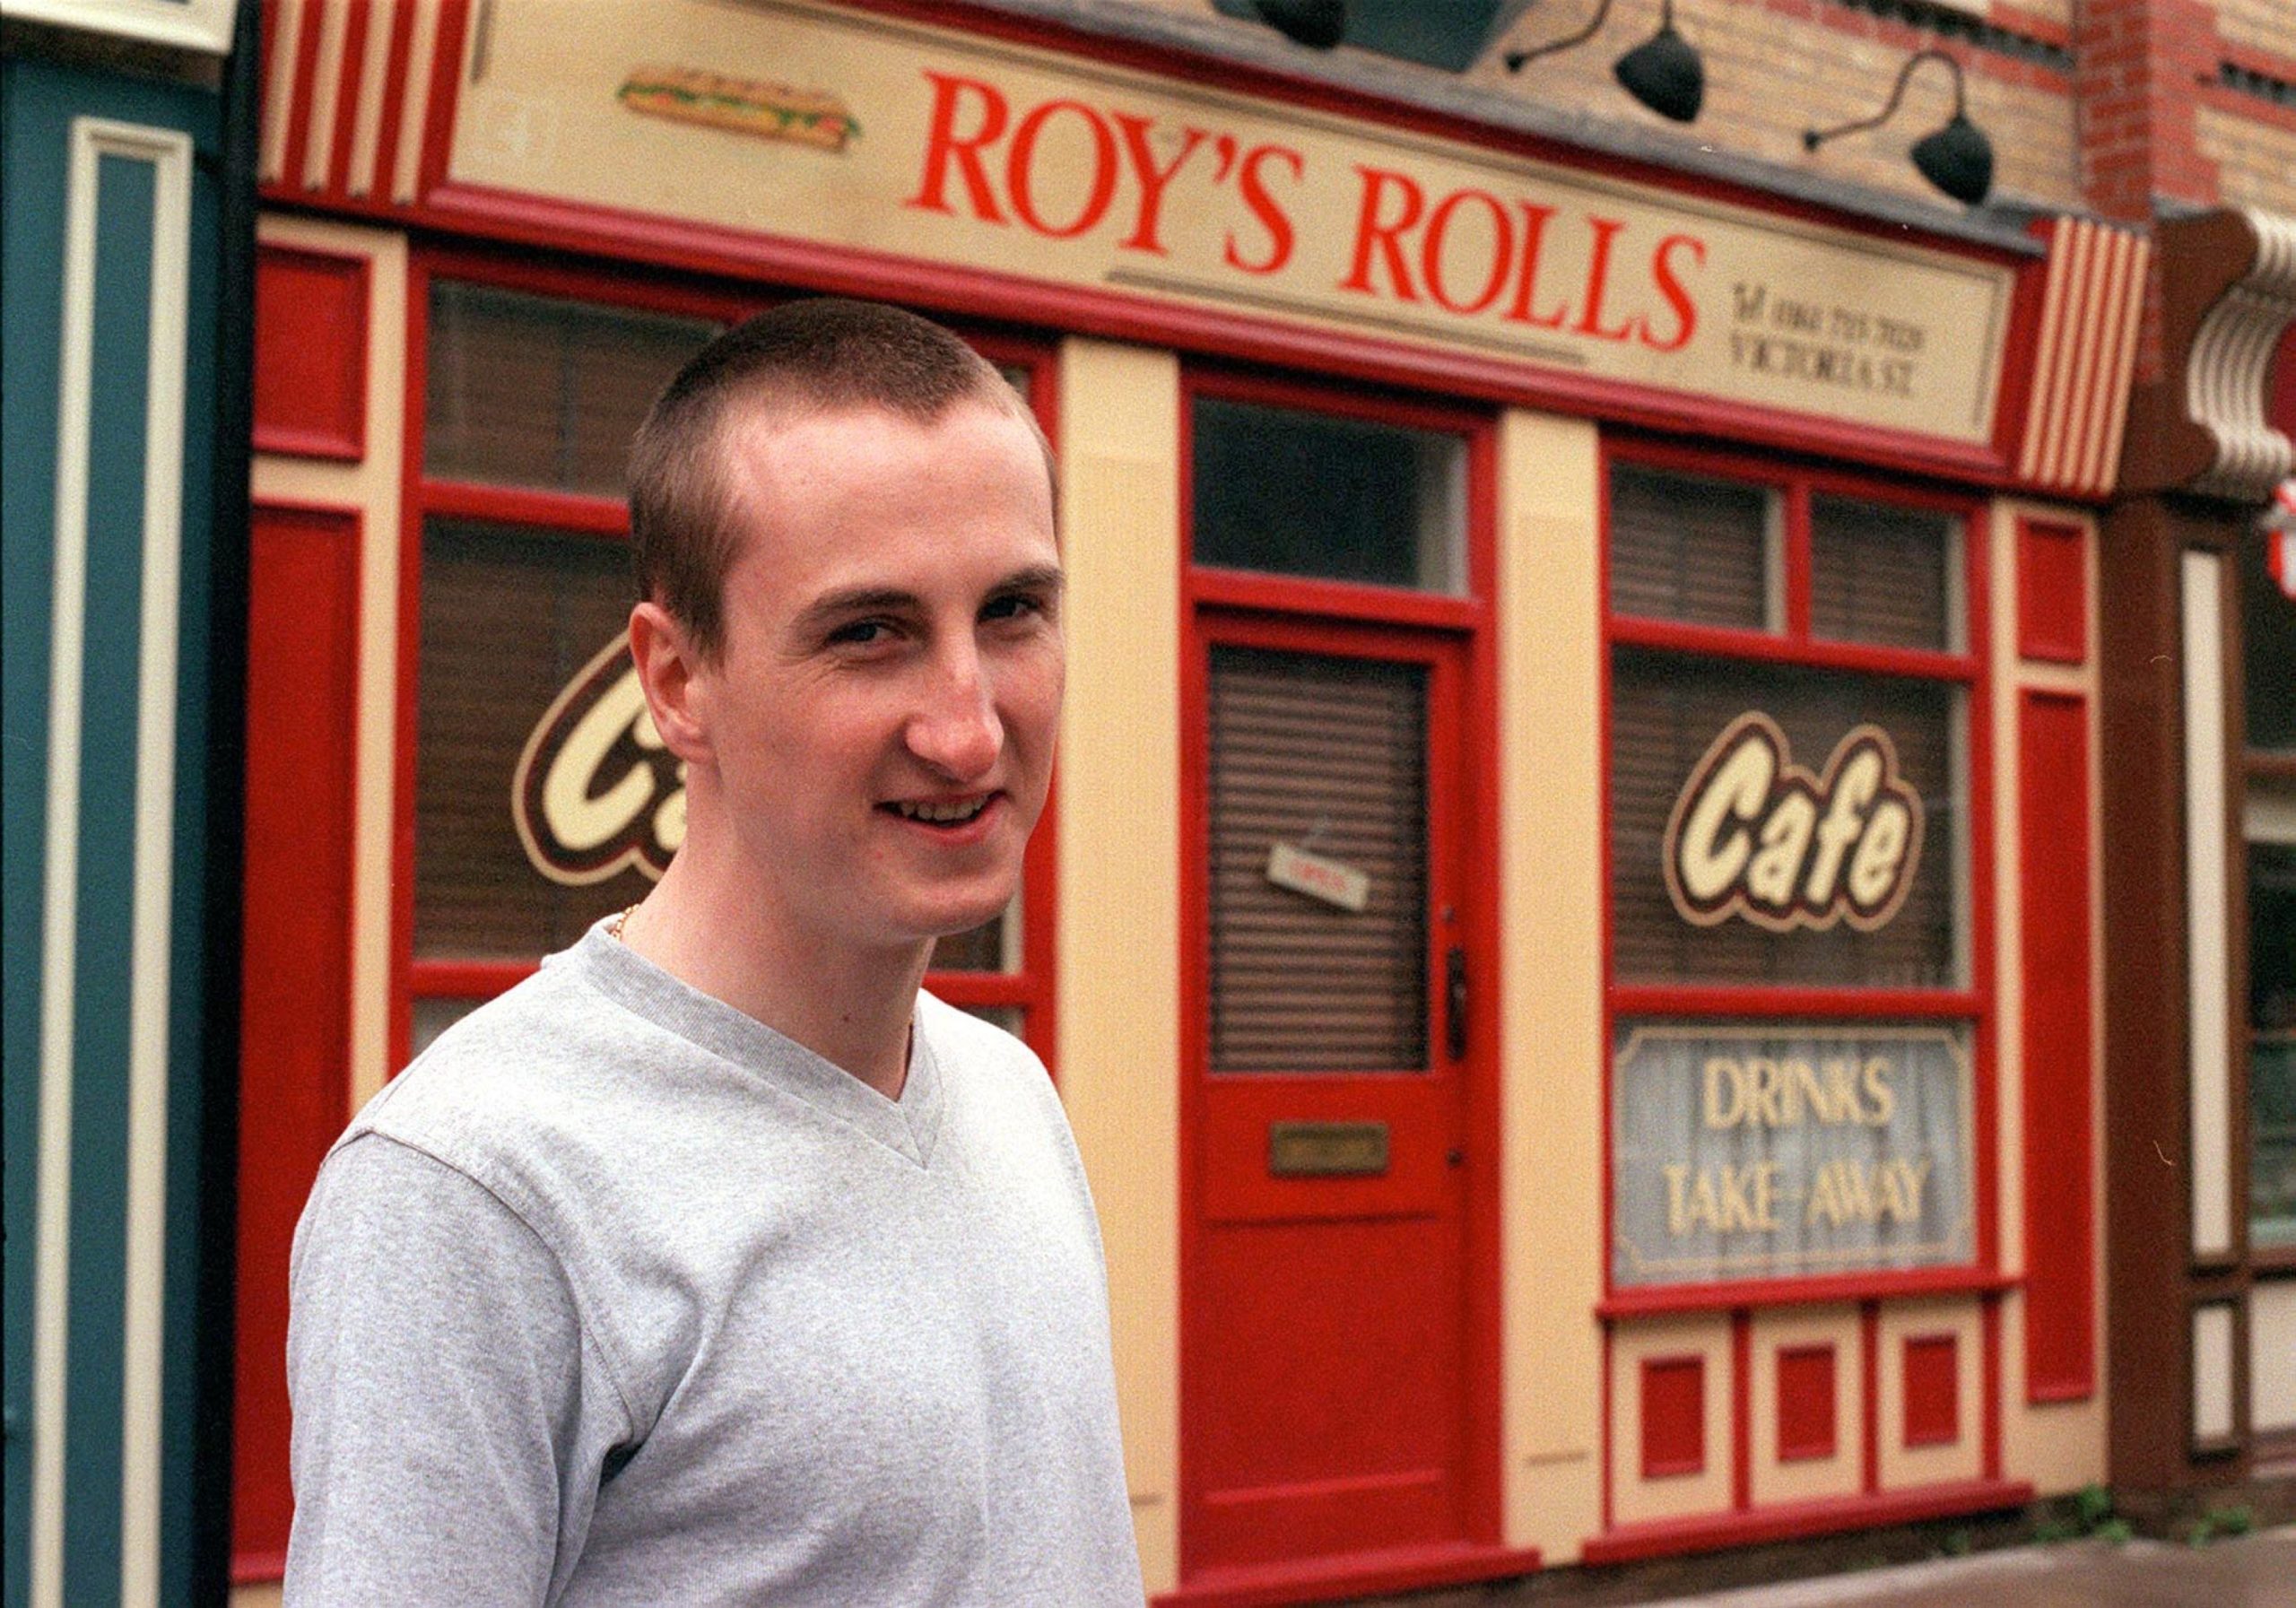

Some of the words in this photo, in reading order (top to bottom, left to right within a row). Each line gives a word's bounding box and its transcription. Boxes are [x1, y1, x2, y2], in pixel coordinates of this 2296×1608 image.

[903, 68, 1305, 276] ROY'S
[1336, 162, 1708, 354] ROLLS
[1680, 735, 1909, 907] Cafe
[1703, 1056, 1892, 1129] DRINKS
